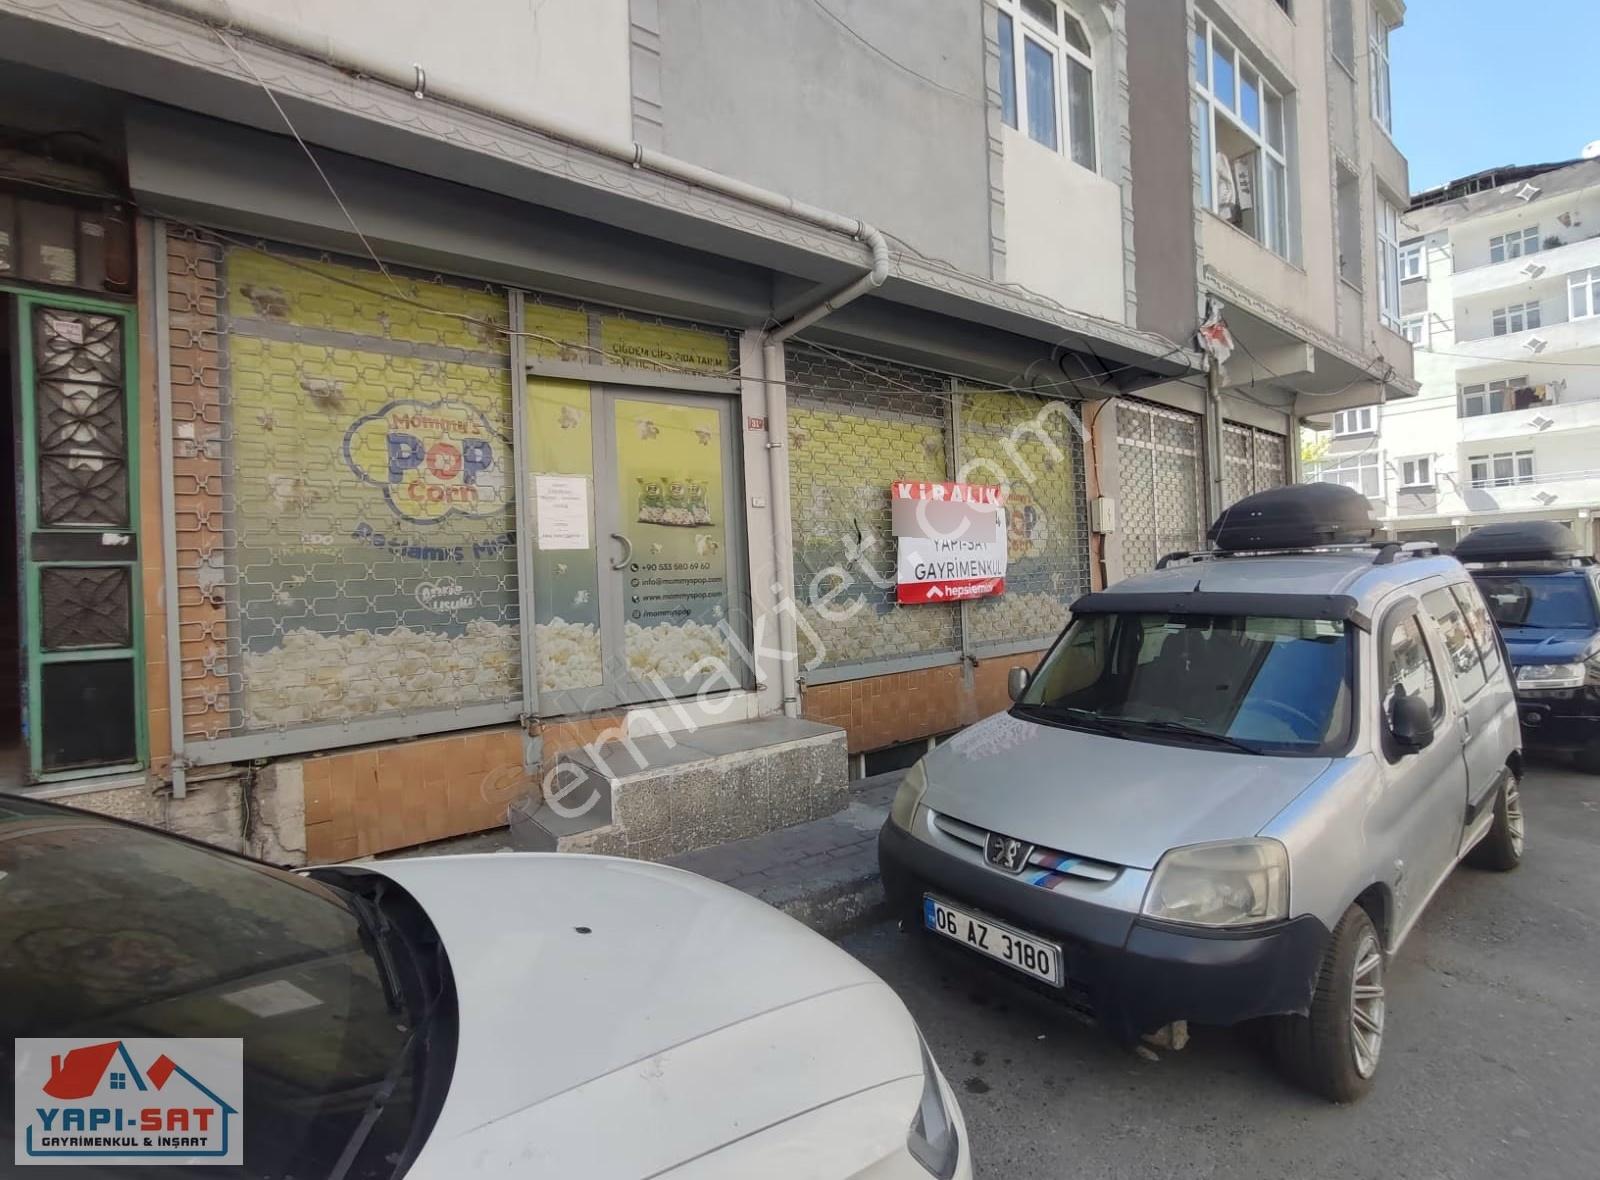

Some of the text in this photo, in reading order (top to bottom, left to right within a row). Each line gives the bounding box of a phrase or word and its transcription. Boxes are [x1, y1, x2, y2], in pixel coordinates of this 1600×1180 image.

[387, 433, 493, 485] POP
[407, 480, 479, 503] Corn
[914, 558, 1002, 580] GAYRİMENKUL
[936, 907, 1050, 975] 06 AZ 3180
